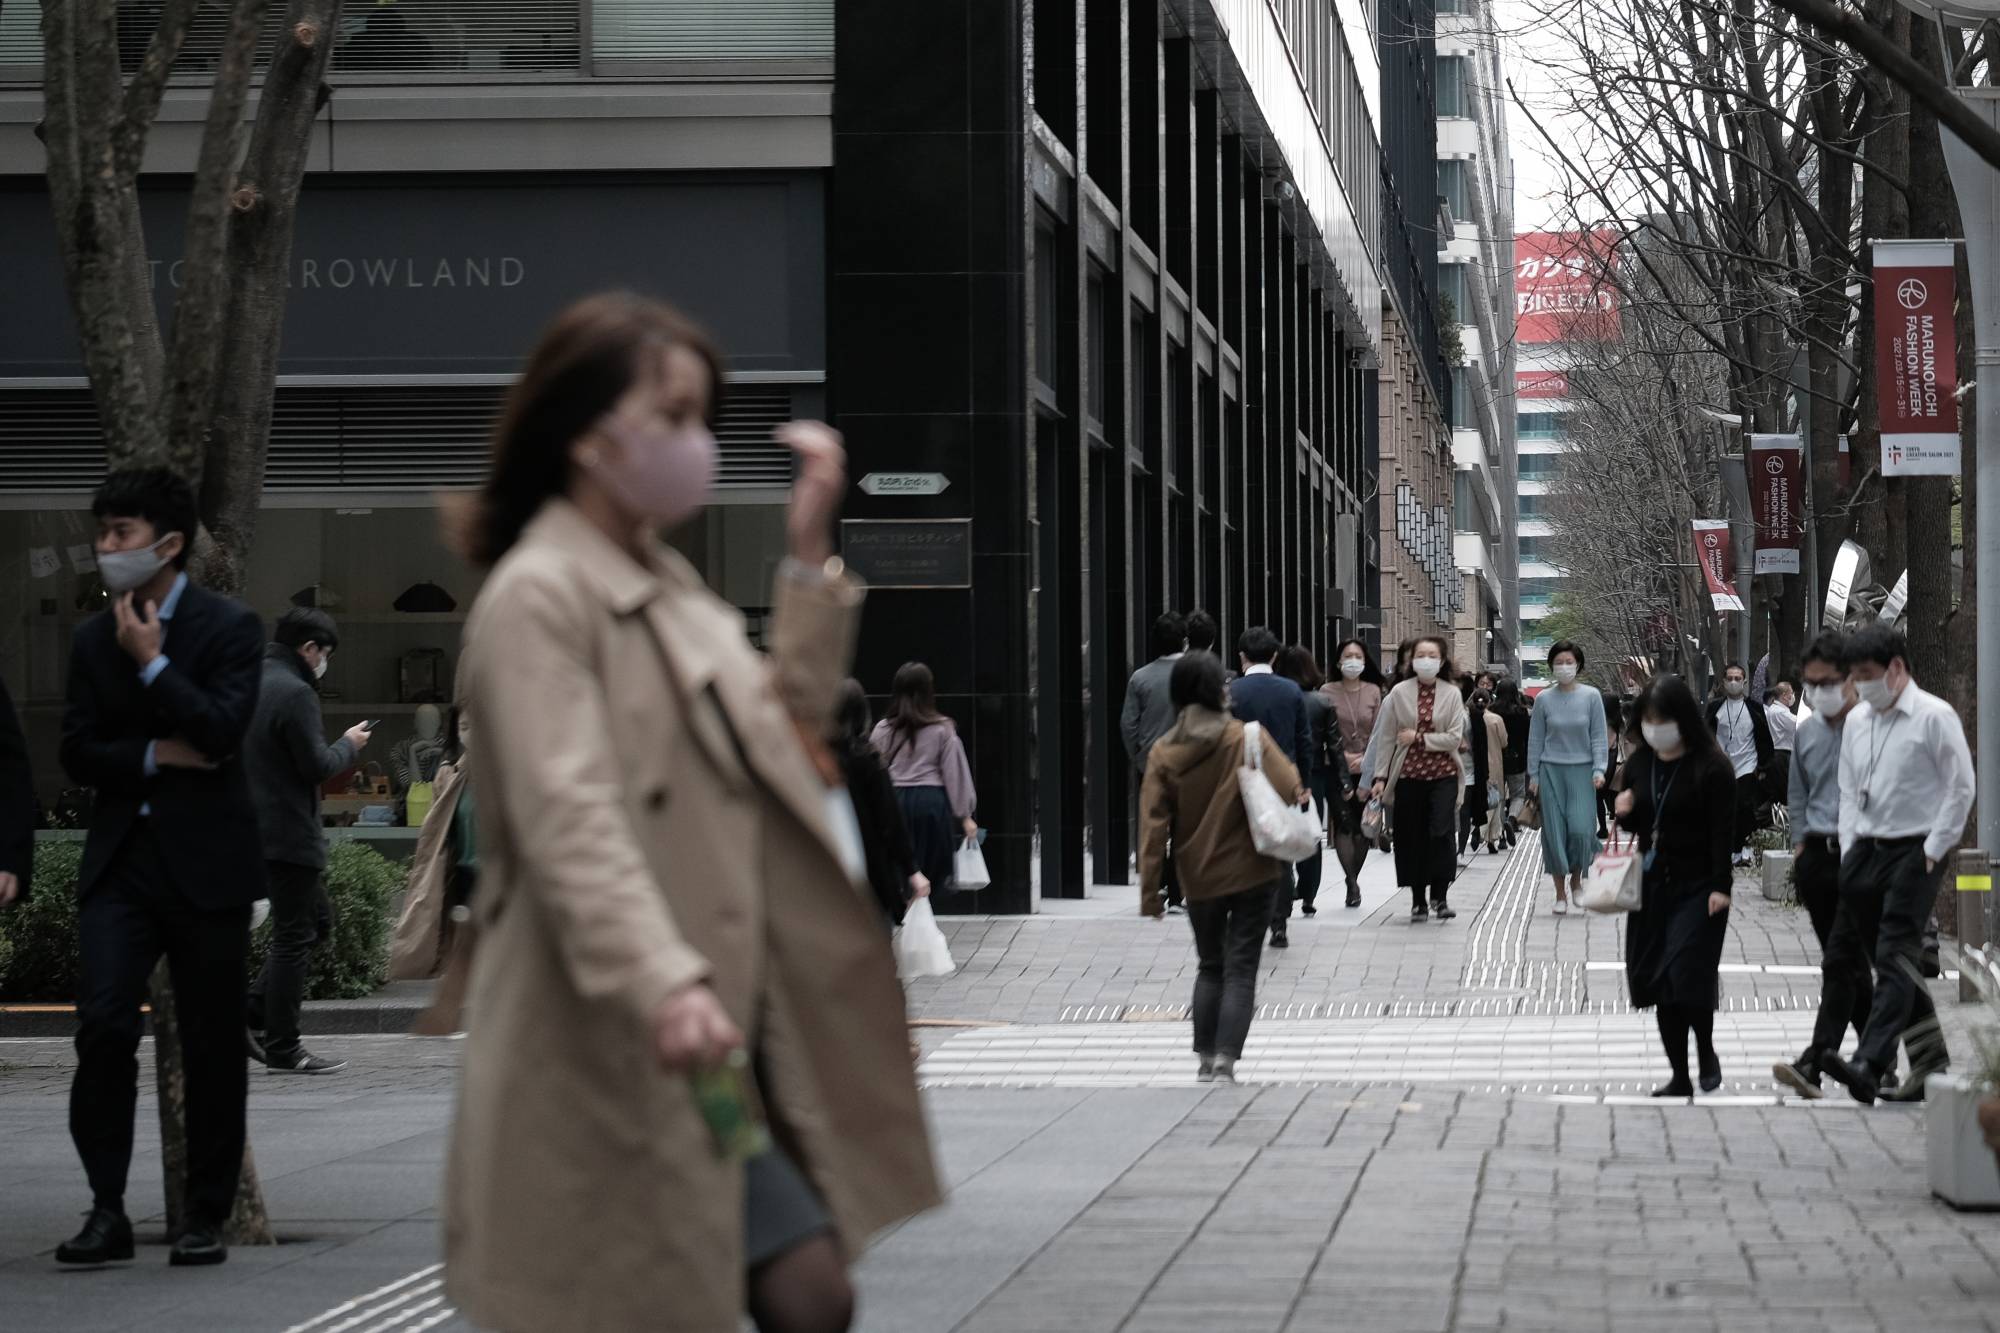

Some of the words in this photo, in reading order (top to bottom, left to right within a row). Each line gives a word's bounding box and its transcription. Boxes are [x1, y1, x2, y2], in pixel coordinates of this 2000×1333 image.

[147, 256, 524, 289] TOROWLAND
[1906, 315, 1919, 375] FASHION
[1921, 315, 1938, 417] MARUNOUCHI
[1910, 379, 1921, 416] WEEK
[1771, 516, 1779, 539] WEEK
[1780, 477, 1788, 539] MARUNOUCHI
